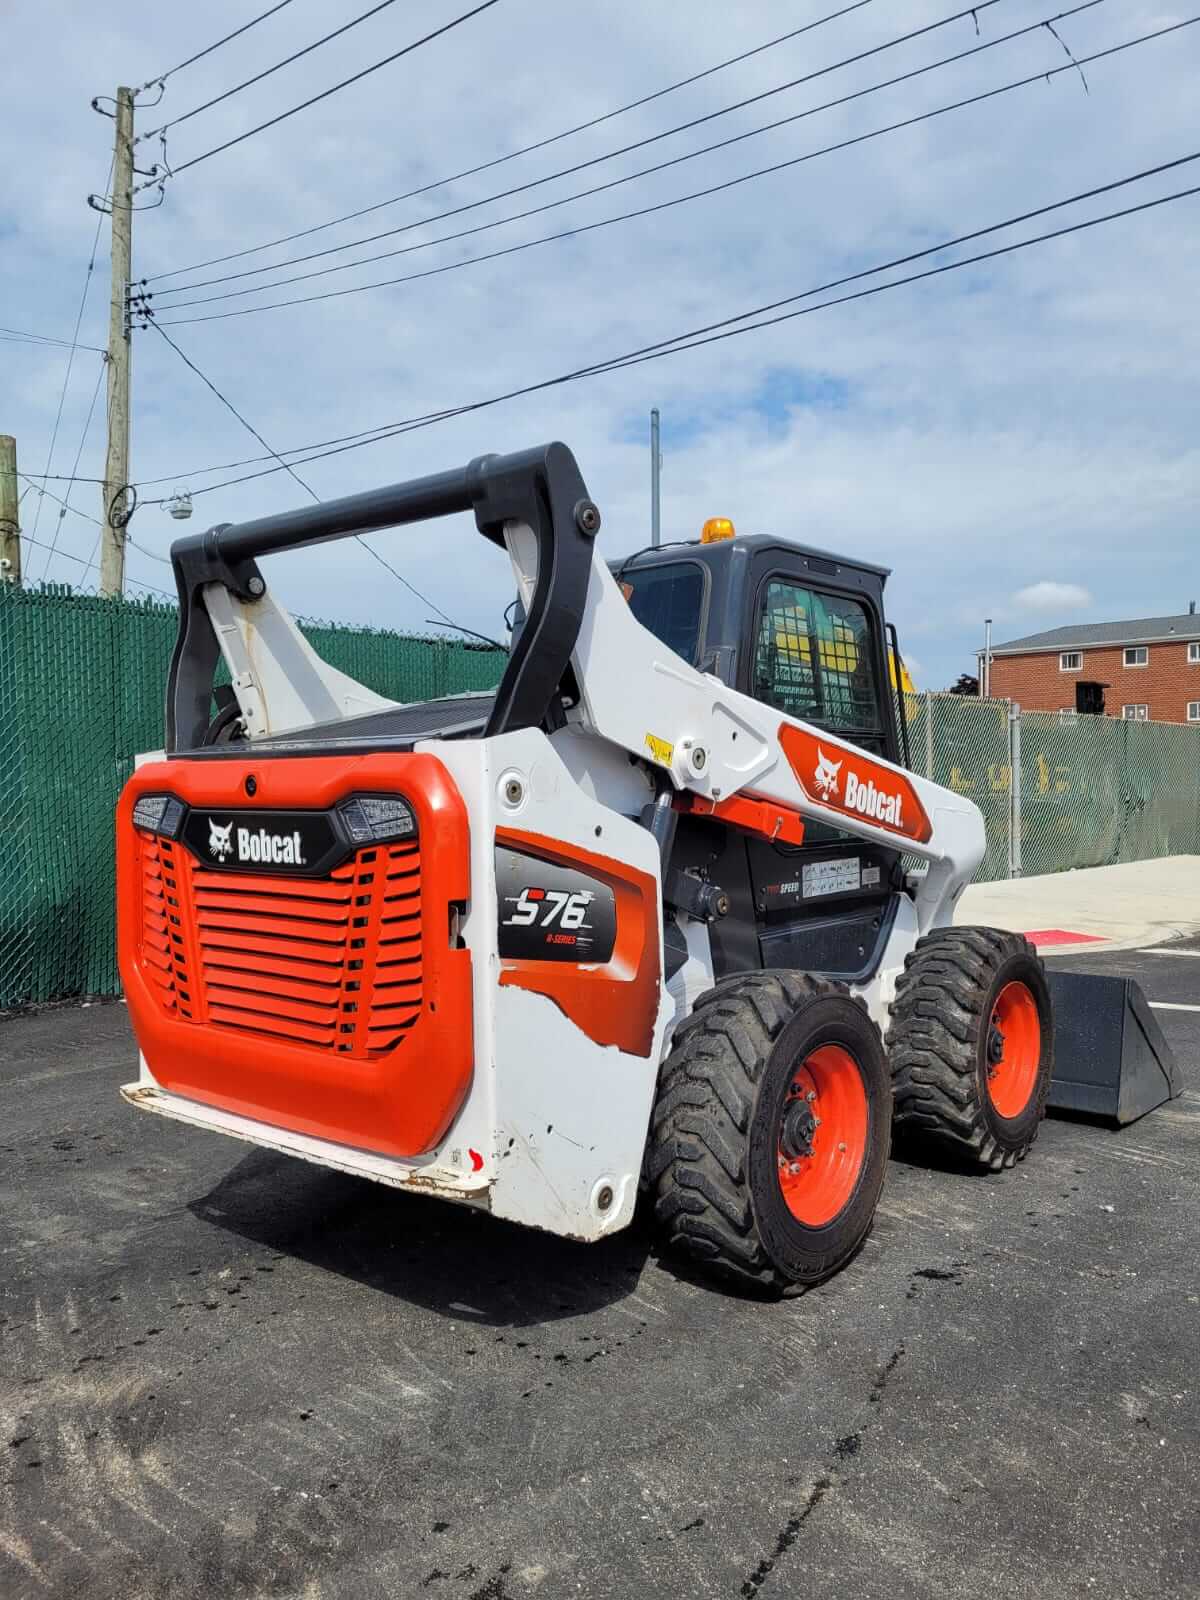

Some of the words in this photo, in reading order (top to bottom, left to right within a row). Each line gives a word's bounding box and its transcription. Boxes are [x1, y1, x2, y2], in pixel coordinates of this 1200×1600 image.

[844, 772, 903, 827] Bobcat
[237, 828, 302, 864] Bobcat
[504, 889, 594, 929] S76
